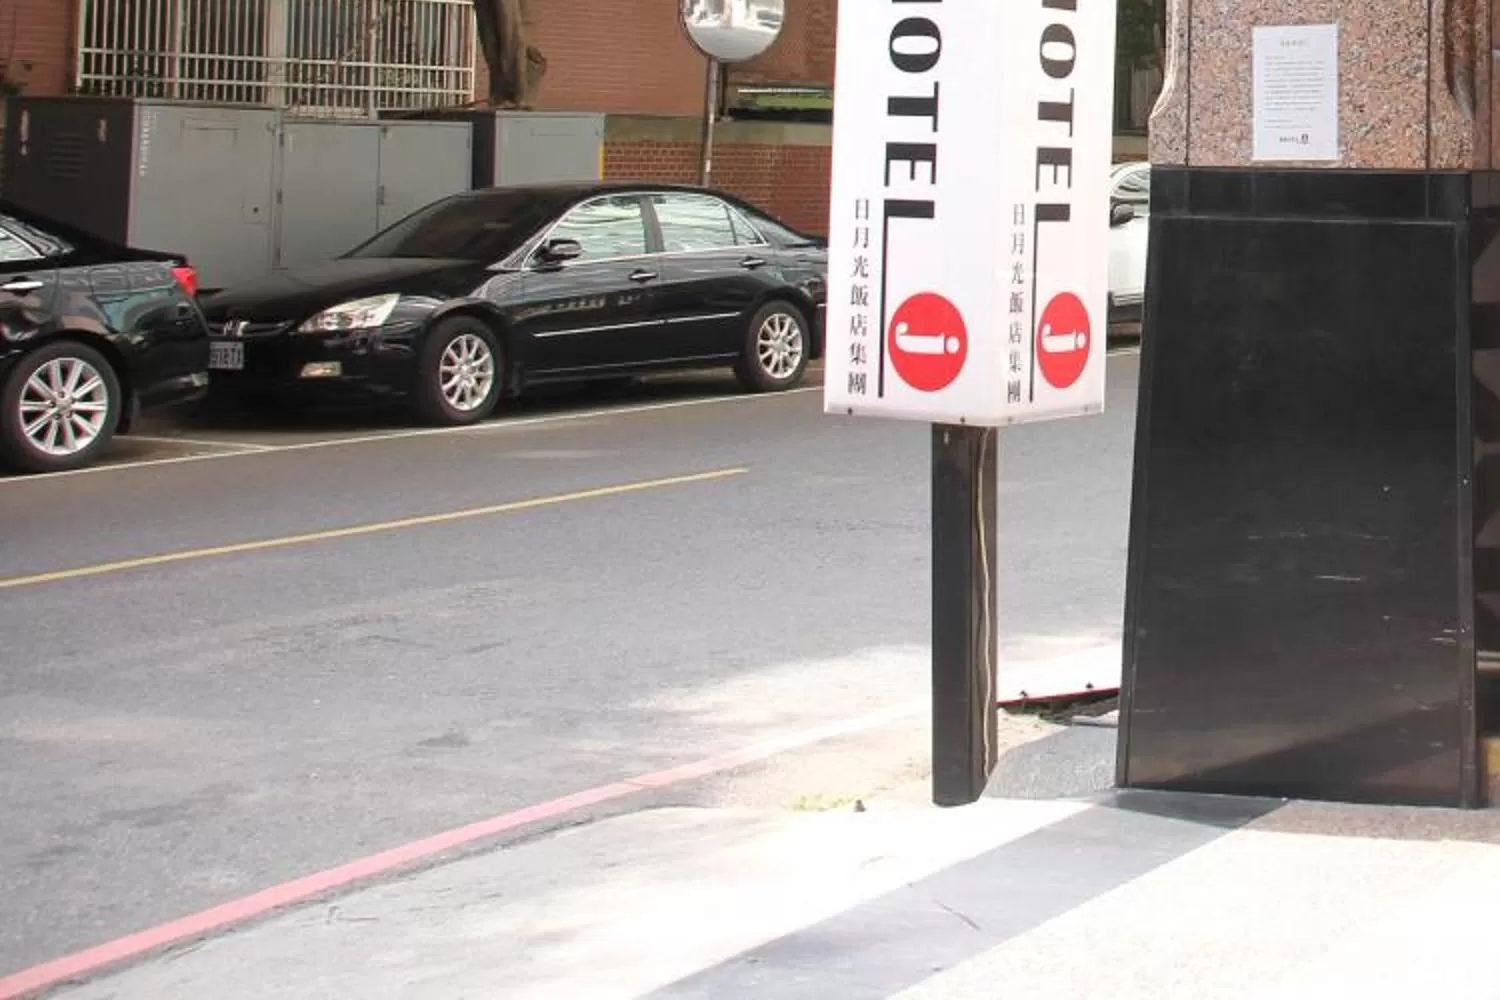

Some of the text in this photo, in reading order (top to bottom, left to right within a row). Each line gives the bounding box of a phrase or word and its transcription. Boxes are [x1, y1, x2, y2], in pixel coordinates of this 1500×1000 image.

[848, 198, 869, 395] 日月光飯店集團
